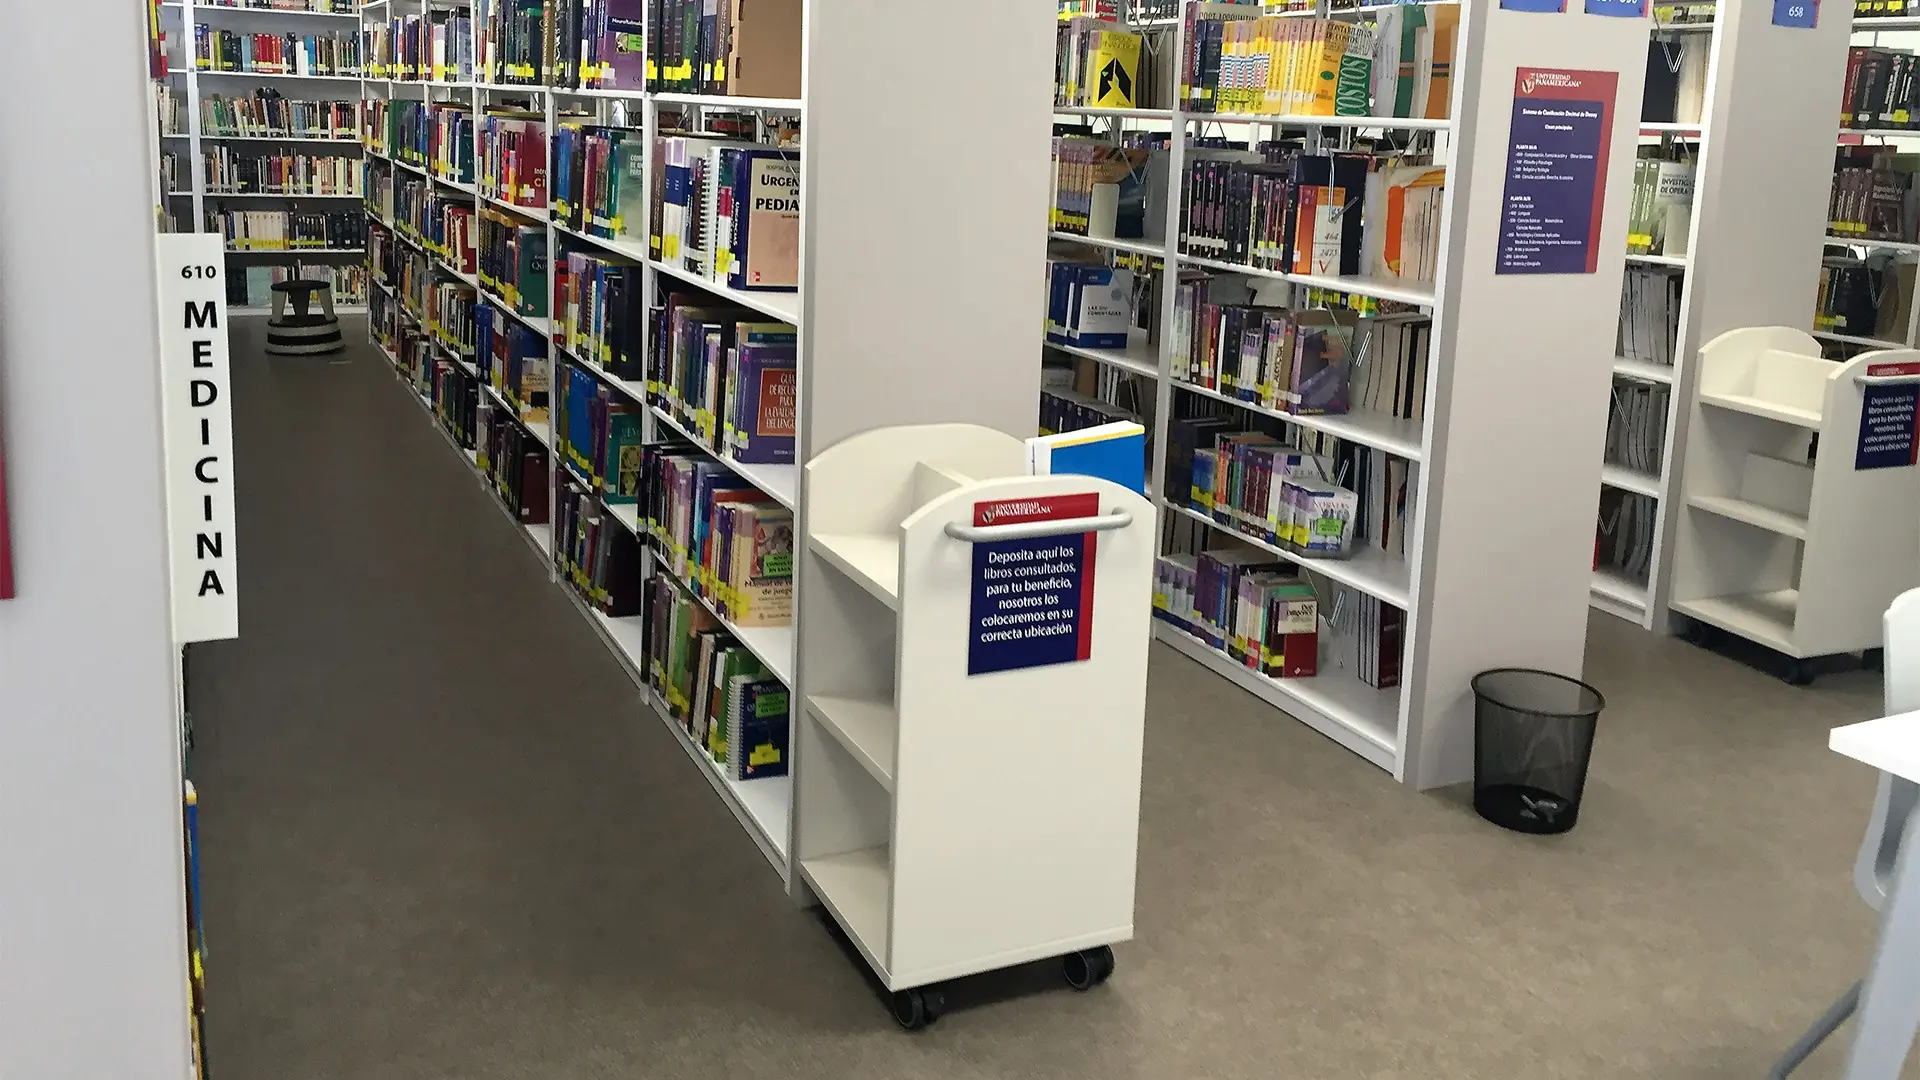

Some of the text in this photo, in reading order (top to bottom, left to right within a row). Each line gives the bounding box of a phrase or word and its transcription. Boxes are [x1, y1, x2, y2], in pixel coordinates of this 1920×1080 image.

[1788, 6, 1804, 18] 658
[1536, 72, 1571, 80] UNIVERSIDAD
[1336, 58, 1368, 116] COSTOS
[756, 198, 799, 211] PEDIA
[181, 265, 216, 280] 610
[184, 301, 224, 597] MEDICINA
[995, 501, 1040, 512] UNIVERSIDAD
[995, 506, 1051, 517] PANAMERICANA
[988, 545, 1074, 565] Deposita aquí los
[984, 561, 1077, 580] libros consultados,
[986, 577, 1072, 598] para tu beneficio,
[998, 593, 1059, 610] nosotros los
[981, 608, 1074, 627] colocaremos en su
[980, 622, 1072, 643] correcta ubicación
